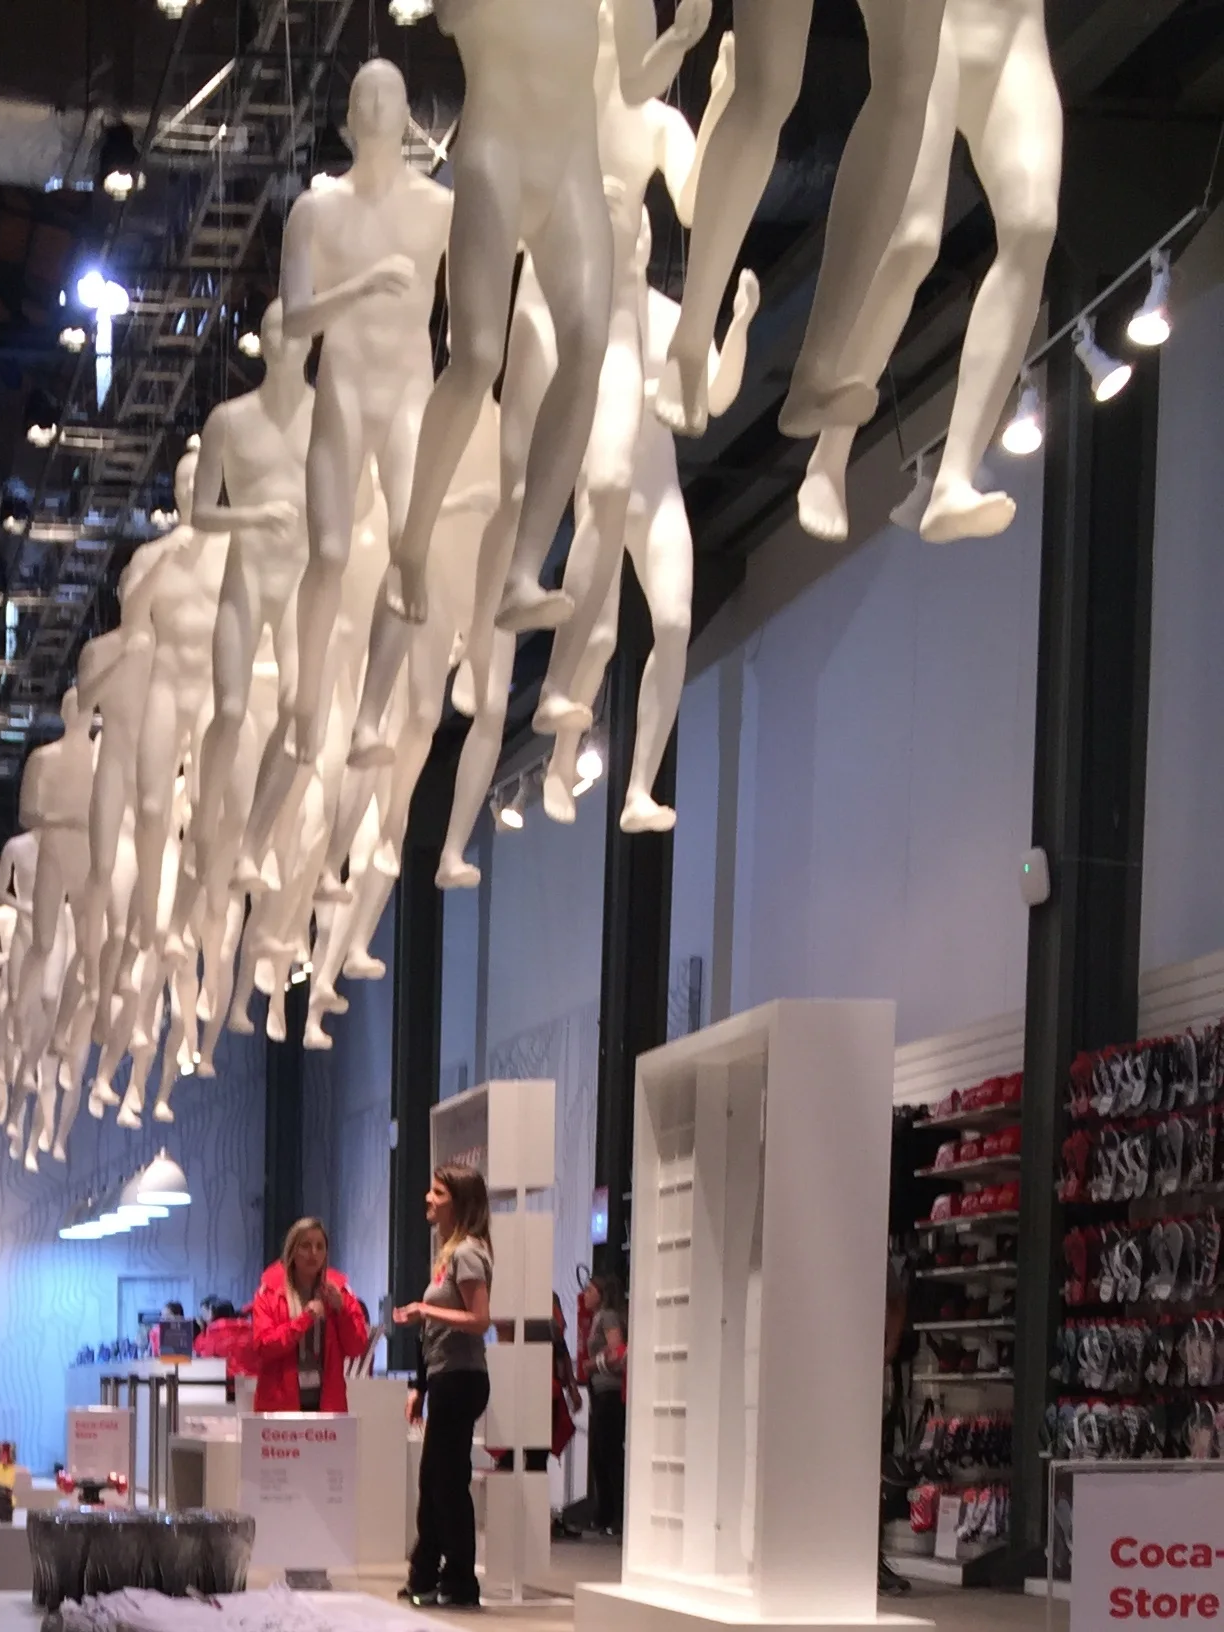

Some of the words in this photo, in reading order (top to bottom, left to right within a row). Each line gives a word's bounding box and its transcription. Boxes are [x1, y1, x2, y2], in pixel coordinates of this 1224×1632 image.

[261, 1428, 337, 1442] Coca-Cola
[261, 1445, 301, 1459] Store
[1109, 1586, 1220, 1619] Store
